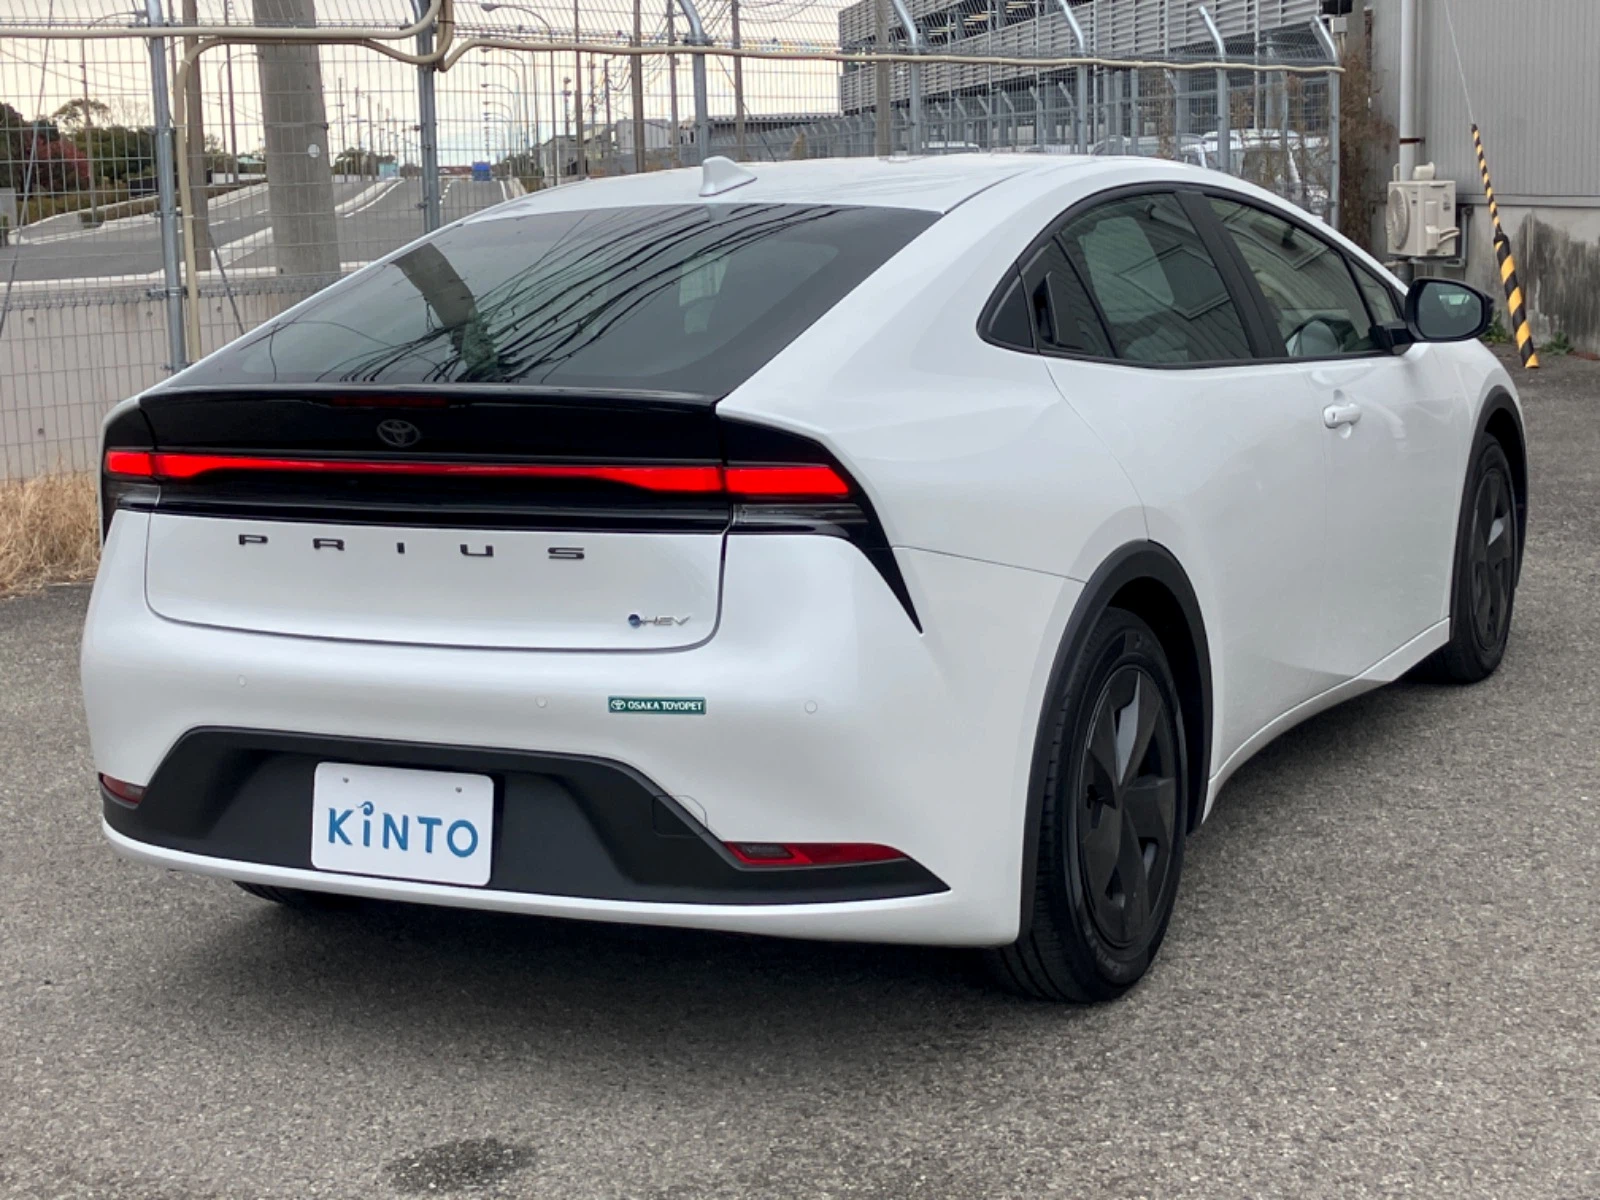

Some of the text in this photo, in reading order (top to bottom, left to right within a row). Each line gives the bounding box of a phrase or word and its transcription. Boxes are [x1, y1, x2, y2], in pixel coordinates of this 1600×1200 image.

[238, 534, 585, 560] PRIUS
[642, 614, 691, 627] HEV
[627, 701, 703, 711] OSAKA TOYOPET
